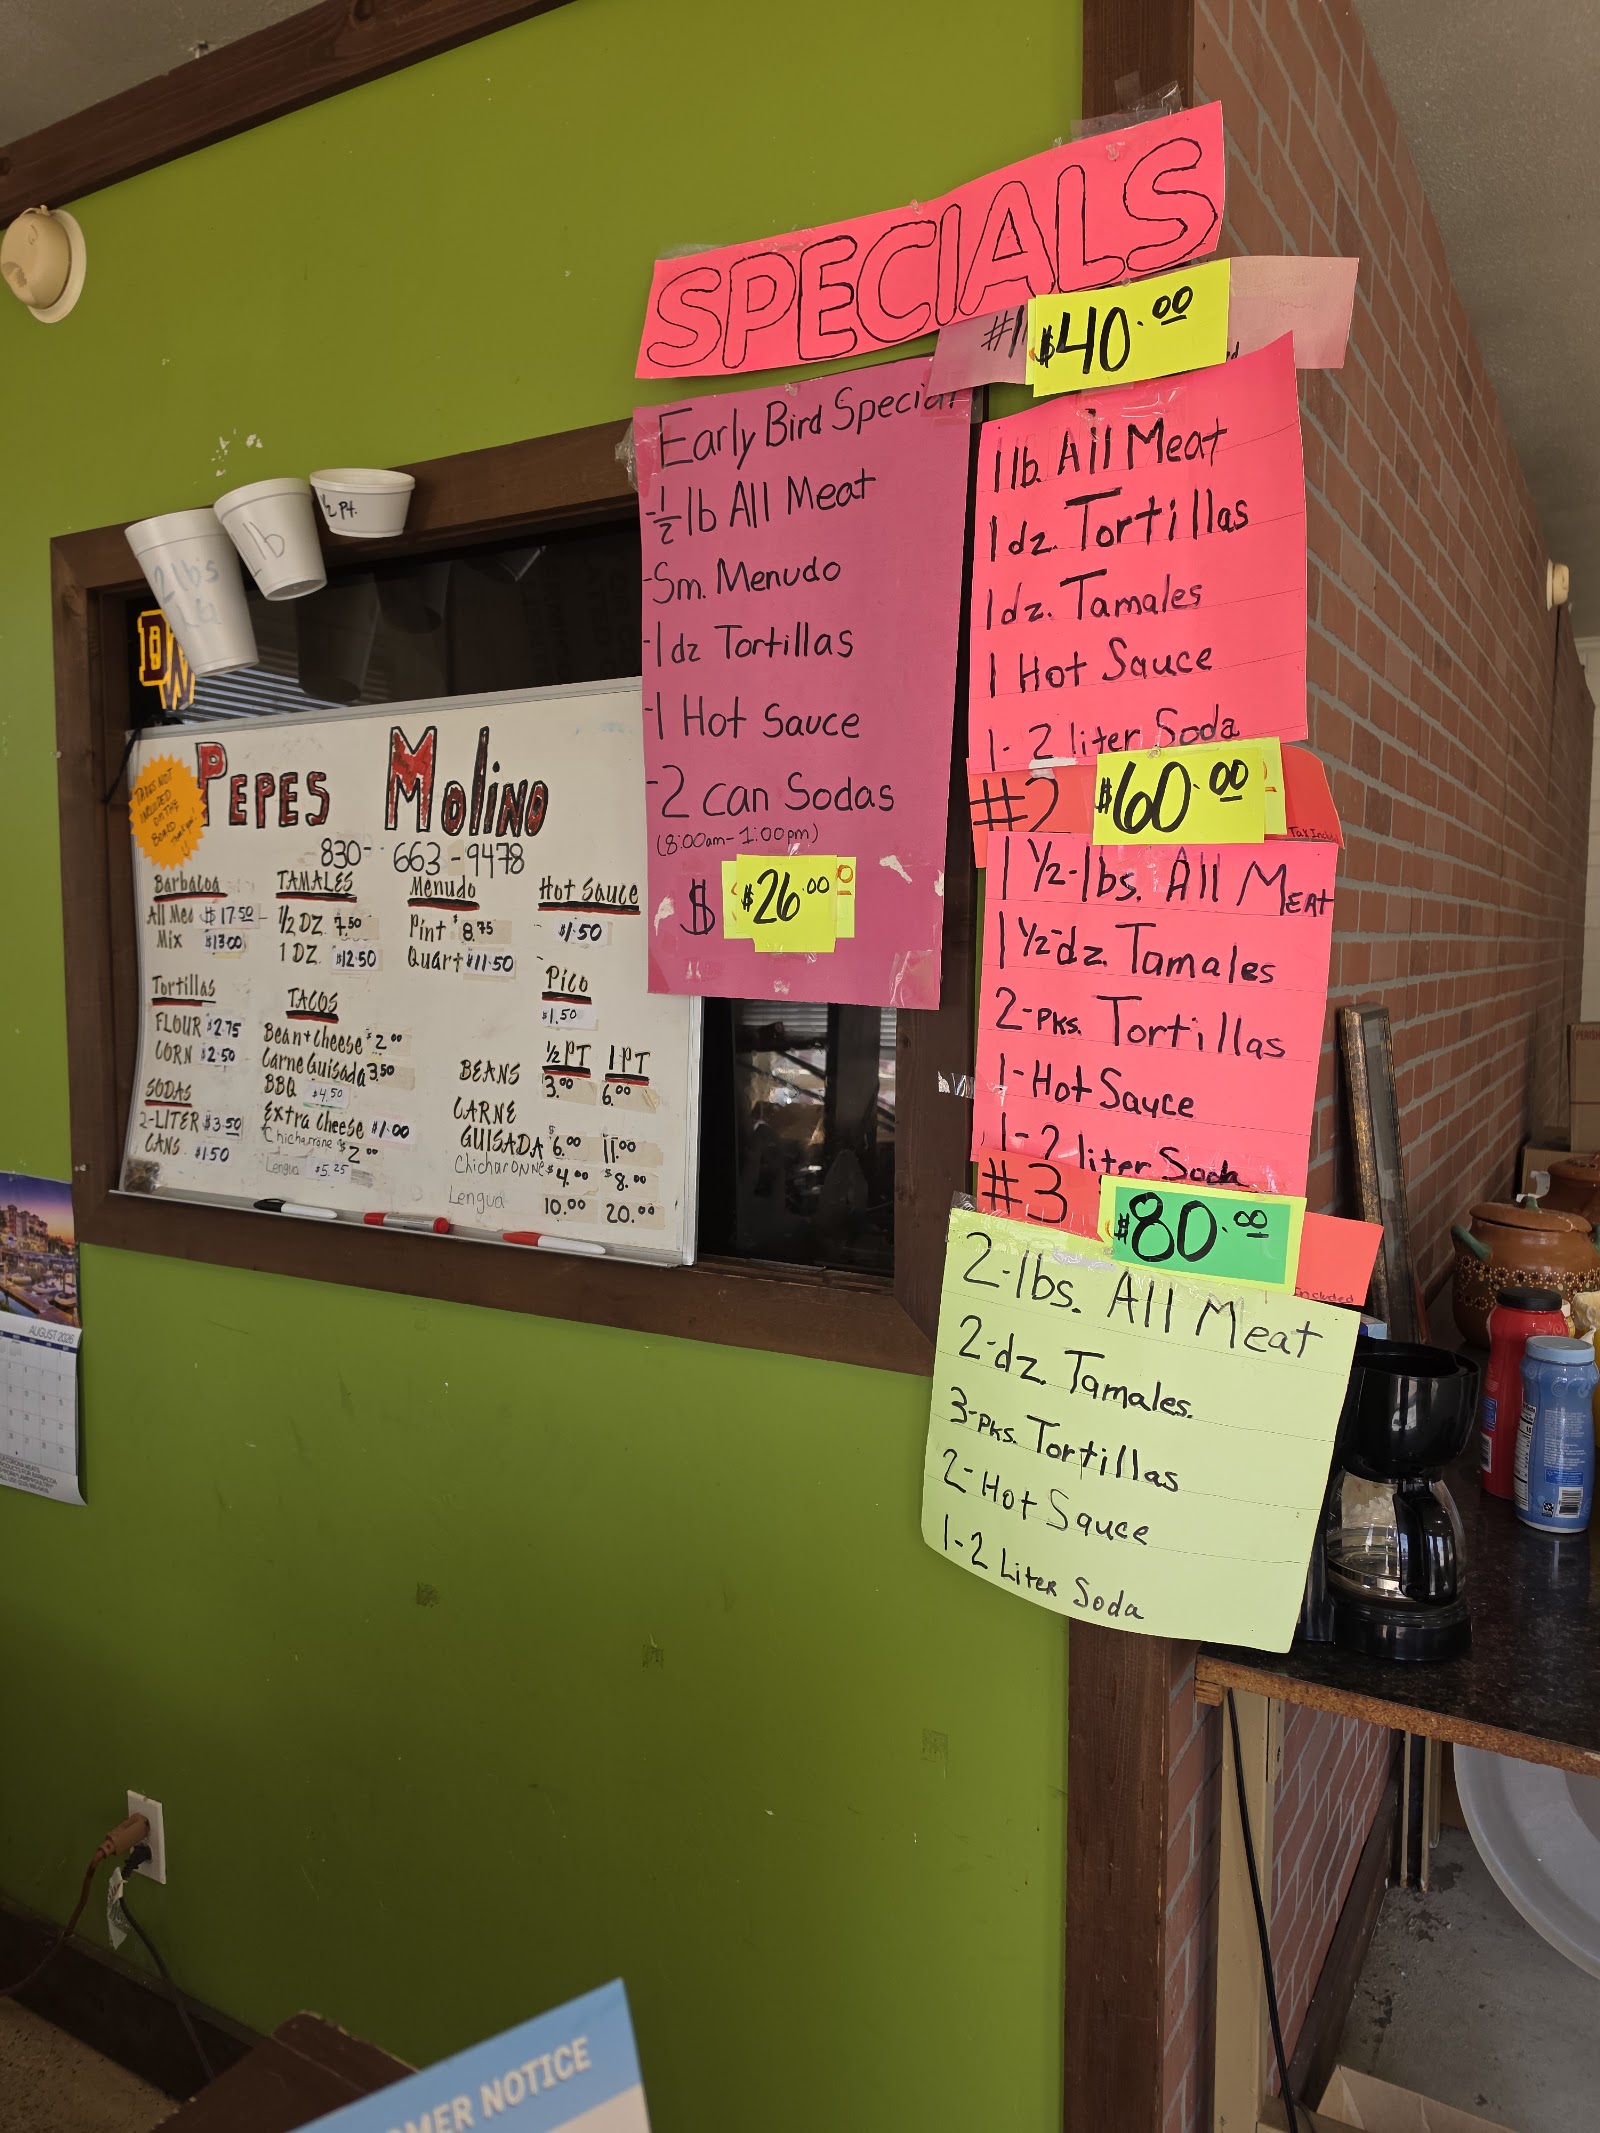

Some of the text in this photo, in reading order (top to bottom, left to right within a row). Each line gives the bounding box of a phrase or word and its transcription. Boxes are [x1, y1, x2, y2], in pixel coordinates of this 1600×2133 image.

[646, 137, 1217, 369] SPECIALS
[659, 407, 756, 470] Early
[766, 401, 822, 447] Bird
[1057, 418, 1112, 475] All
[1128, 418, 1228, 470] Meat
[729, 480, 770, 528] All
[787, 468, 876, 515] Meat
[1064, 487, 1249, 551] Tortillas
[716, 556, 841, 595] Menudo
[1060, 569, 1202, 620] Tamales
[714, 621, 854, 660] Tortillas
[1019, 651, 1087, 693] Hot
[1102, 637, 1212, 681] Sauce
[684, 694, 747, 740] Hot
[762, 703, 860, 739] Sauce
[1070, 721, 1140, 757] liter
[1155, 703, 1241, 747] Soda
[195, 741, 330, 829] PEPES
[785, 771, 895, 812] Sodas
[154, 871, 220, 893] Barbacoa
[277, 870, 353, 892] TAMALES
[410, 875, 476, 898] Menudo
[540, 876, 639, 904] Hot Sauce
[1166, 847, 1221, 902] All
[156, 930, 183, 949] Mix
[409, 913, 447, 943] Pint
[408, 945, 463, 972] Quart
[1115, 923, 1276, 984] Tamales
[152, 974, 216, 998] Tortillas
[545, 965, 588, 993] Pico
[287, 987, 338, 1013] TACOS
[155, 1012, 202, 1038] FLOUR
[1096, 995, 1286, 1060] Tortillas
[155, 1041, 192, 1065] CORN
[262, 1047, 304, 1074] Carne
[307, 1053, 366, 1087] Guisada
[459, 1059, 521, 1085] BEANS
[565, 1040, 592, 1066] PT
[621, 1047, 651, 1074] PT
[145, 1077, 191, 1101] SODAS
[264, 1073, 297, 1097] BBQ
[1100, 1067, 1195, 1119] Sauce
[264, 1100, 310, 1130] Extra
[316, 1111, 364, 1140] Cheese
[453, 1096, 517, 1125] CARNE
[144, 1132, 180, 1155] CANS
[460, 1125, 544, 1159] GUISADA
[266, 1156, 300, 1176] Lengua
[449, 1185, 505, 1214] Lengua
[606, 1203, 655, 1224] 20.00
[981, 1157, 1068, 1224] #3
[29, 1325, 58, 1340] AUGUST
[1107, 1270, 1174, 1334] All
[1195, 1297, 1323, 1359] Meat
[1025, 1414, 1180, 1493] Tortillas
[1046, 1488, 1150, 1546] Sauce
[1074, 1577, 1145, 1622] Soda
[480, 2035, 593, 2120] NOTICE
